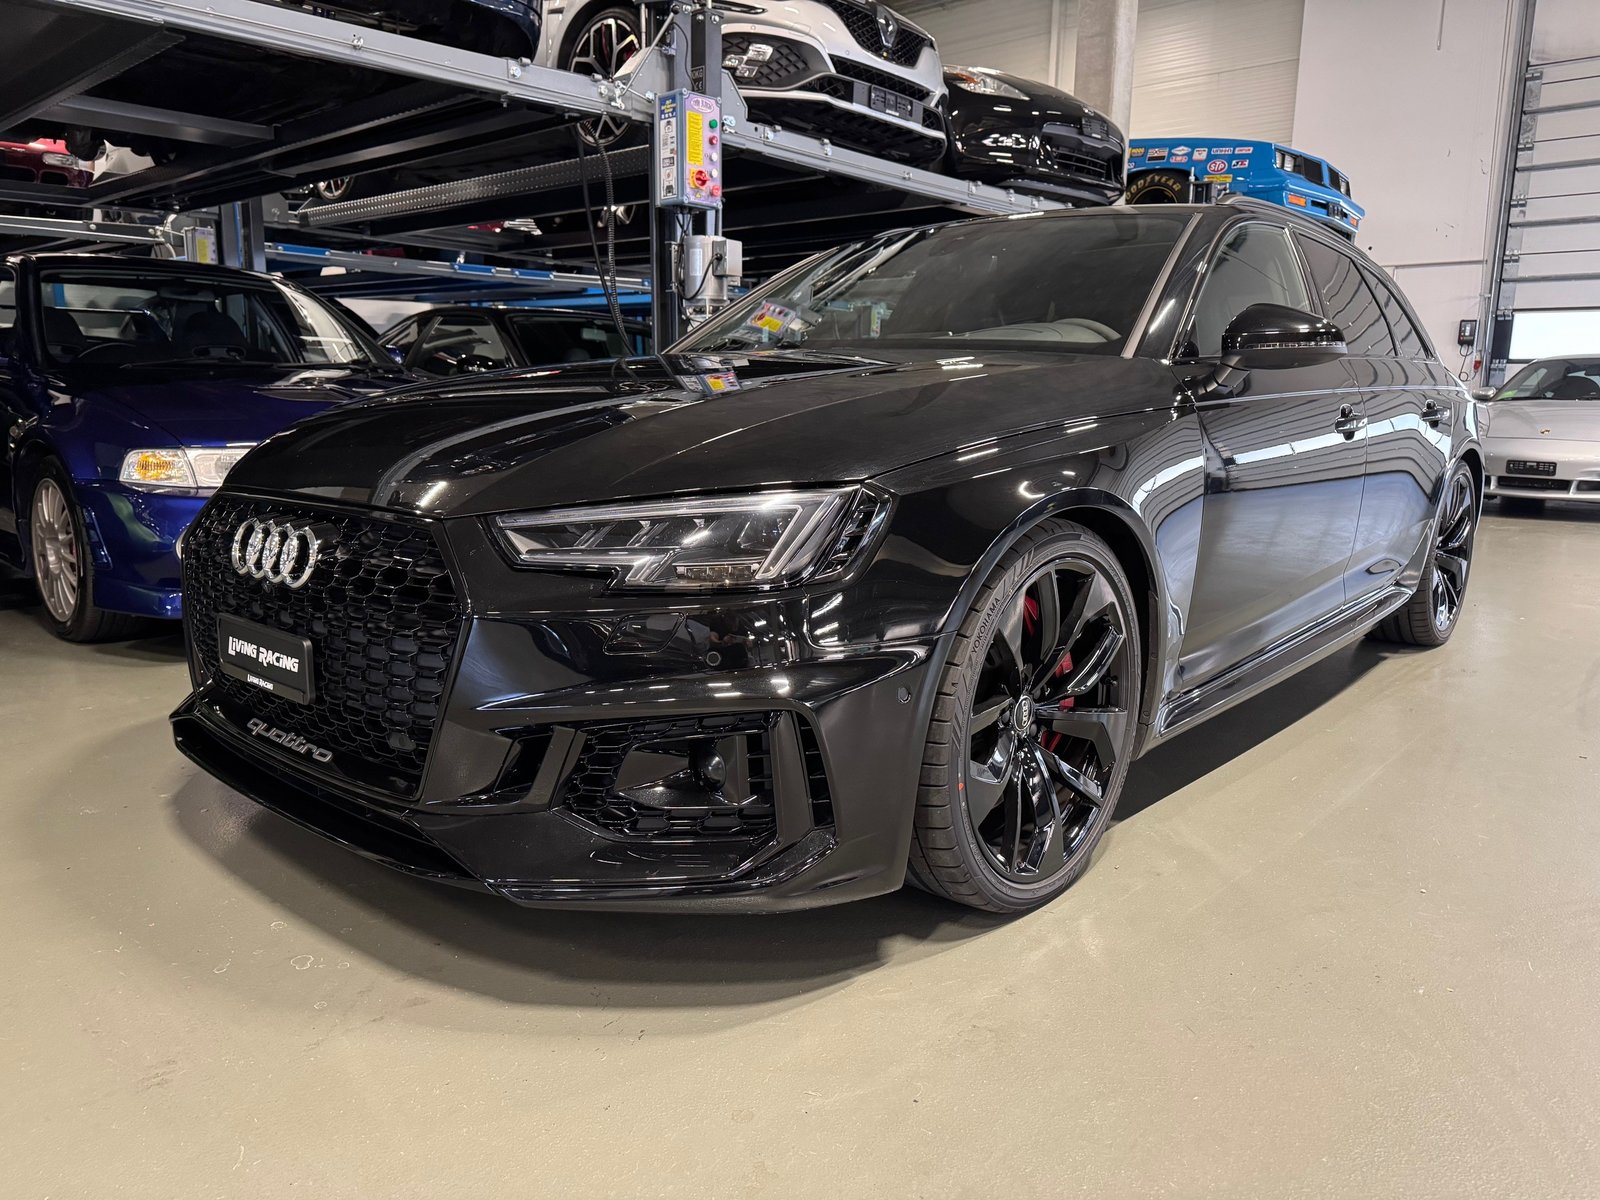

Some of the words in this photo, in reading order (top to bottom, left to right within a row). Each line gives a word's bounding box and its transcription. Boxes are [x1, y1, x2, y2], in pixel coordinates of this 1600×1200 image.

[1209, 162, 1225, 171] STP
[971, 597, 1000, 653] YOKOHAMA
[247, 718, 333, 762] quattro
